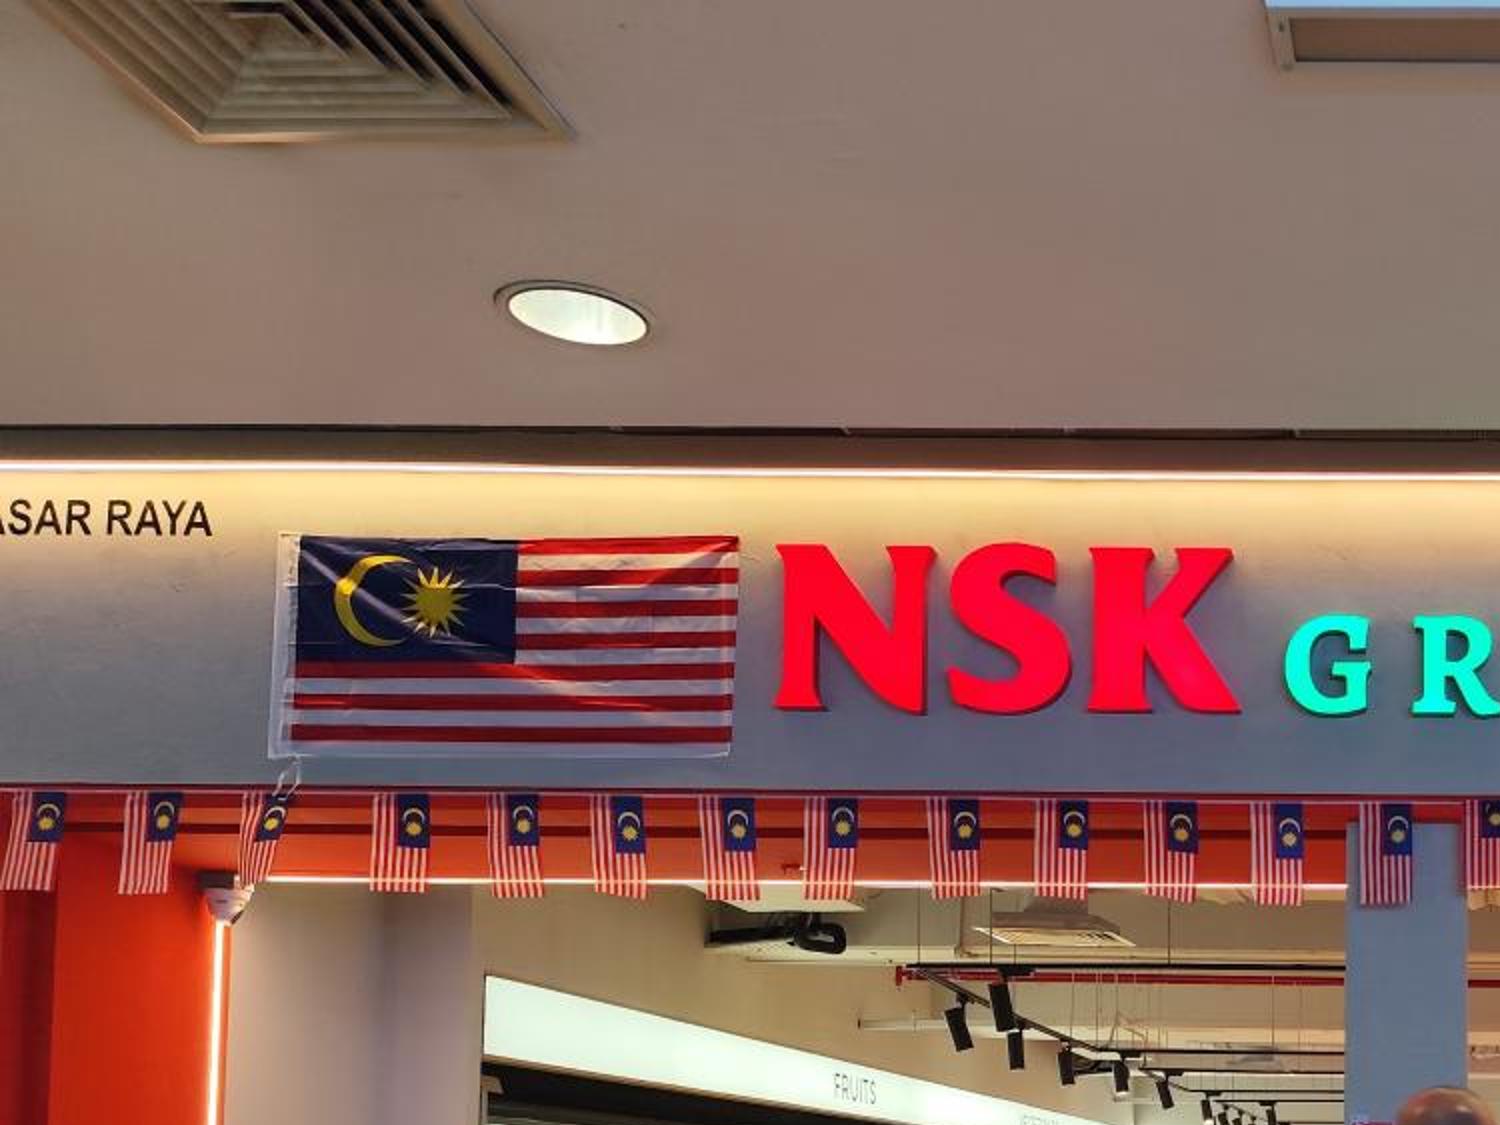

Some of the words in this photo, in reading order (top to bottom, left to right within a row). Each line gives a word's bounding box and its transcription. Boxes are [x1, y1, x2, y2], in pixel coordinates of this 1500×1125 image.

[0, 499, 92, 536] SAR
[106, 499, 213, 537] RAYA
[774, 542, 1240, 715] NSK
[834, 1073, 877, 1104] FRUITS
